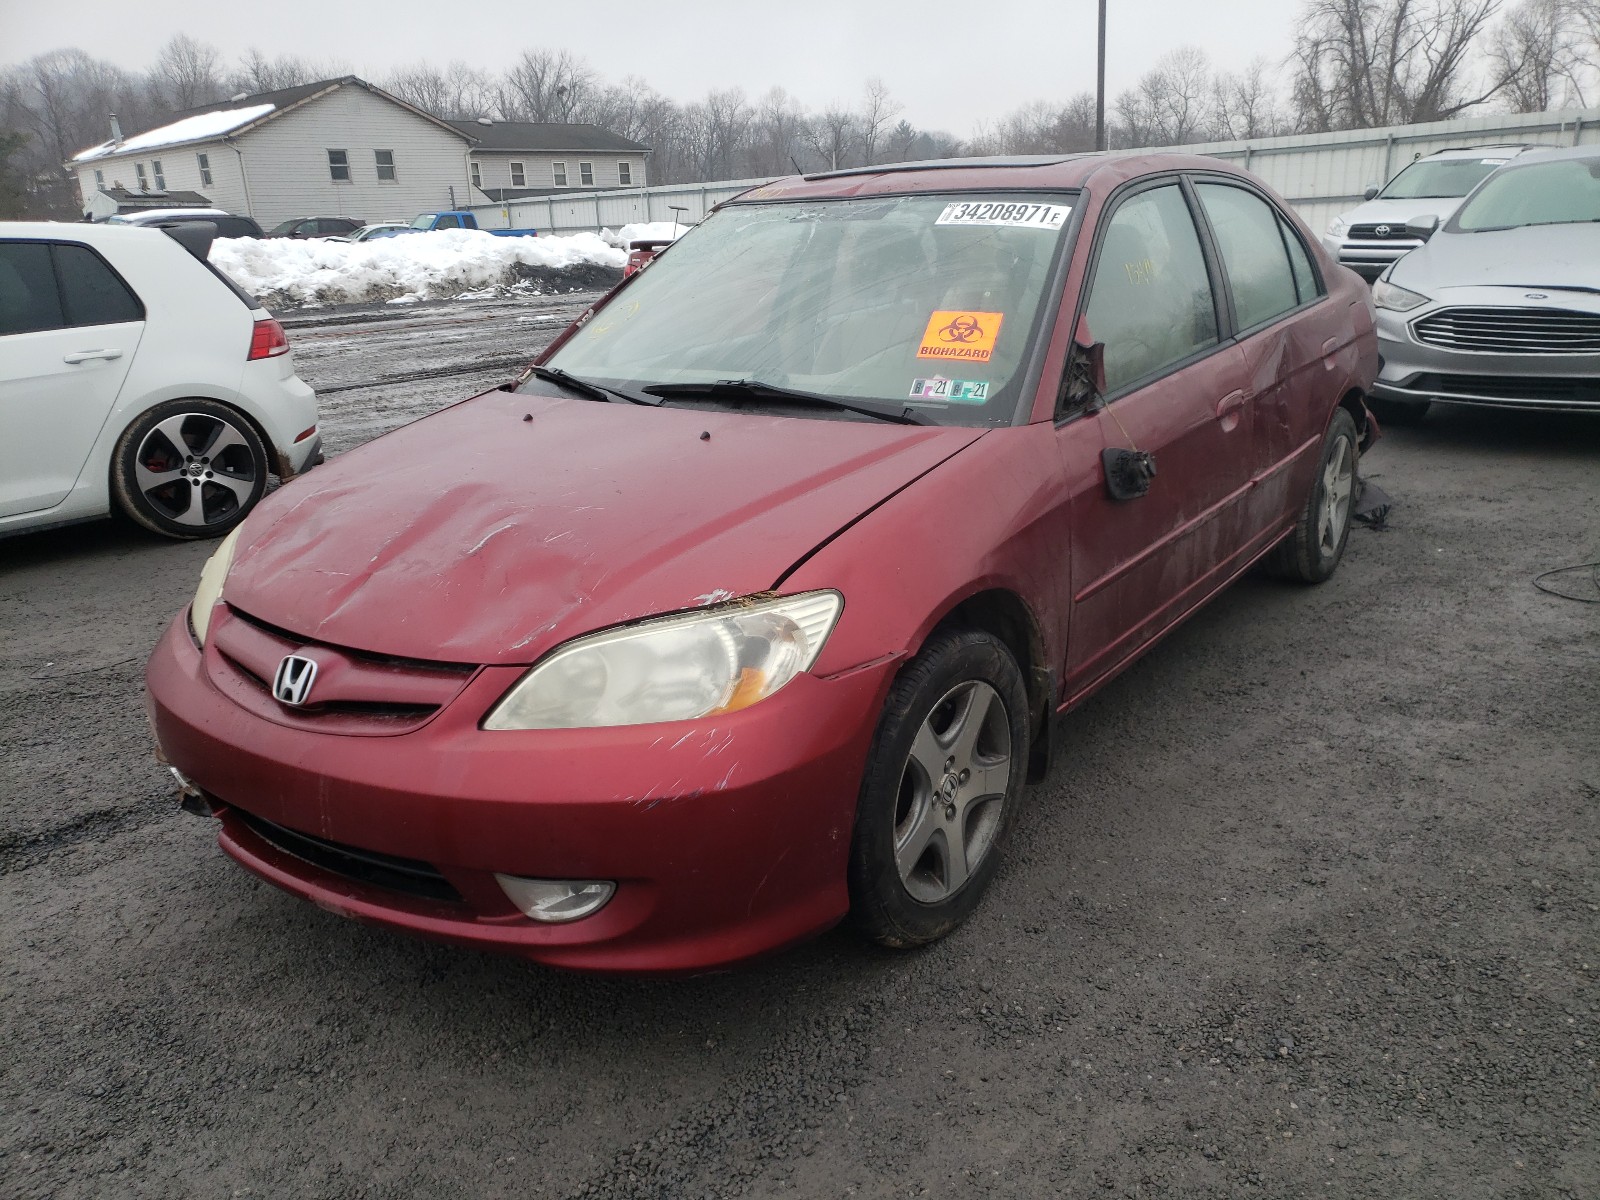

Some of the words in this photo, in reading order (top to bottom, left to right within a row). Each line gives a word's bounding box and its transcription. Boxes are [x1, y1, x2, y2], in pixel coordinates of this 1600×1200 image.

[954, 203, 1052, 223] 34208971
[1050, 213, 1060, 222] F
[920, 346, 990, 358] BIOHAZARD
[935, 380, 948, 394] 21
[973, 383, 986, 397] 21
